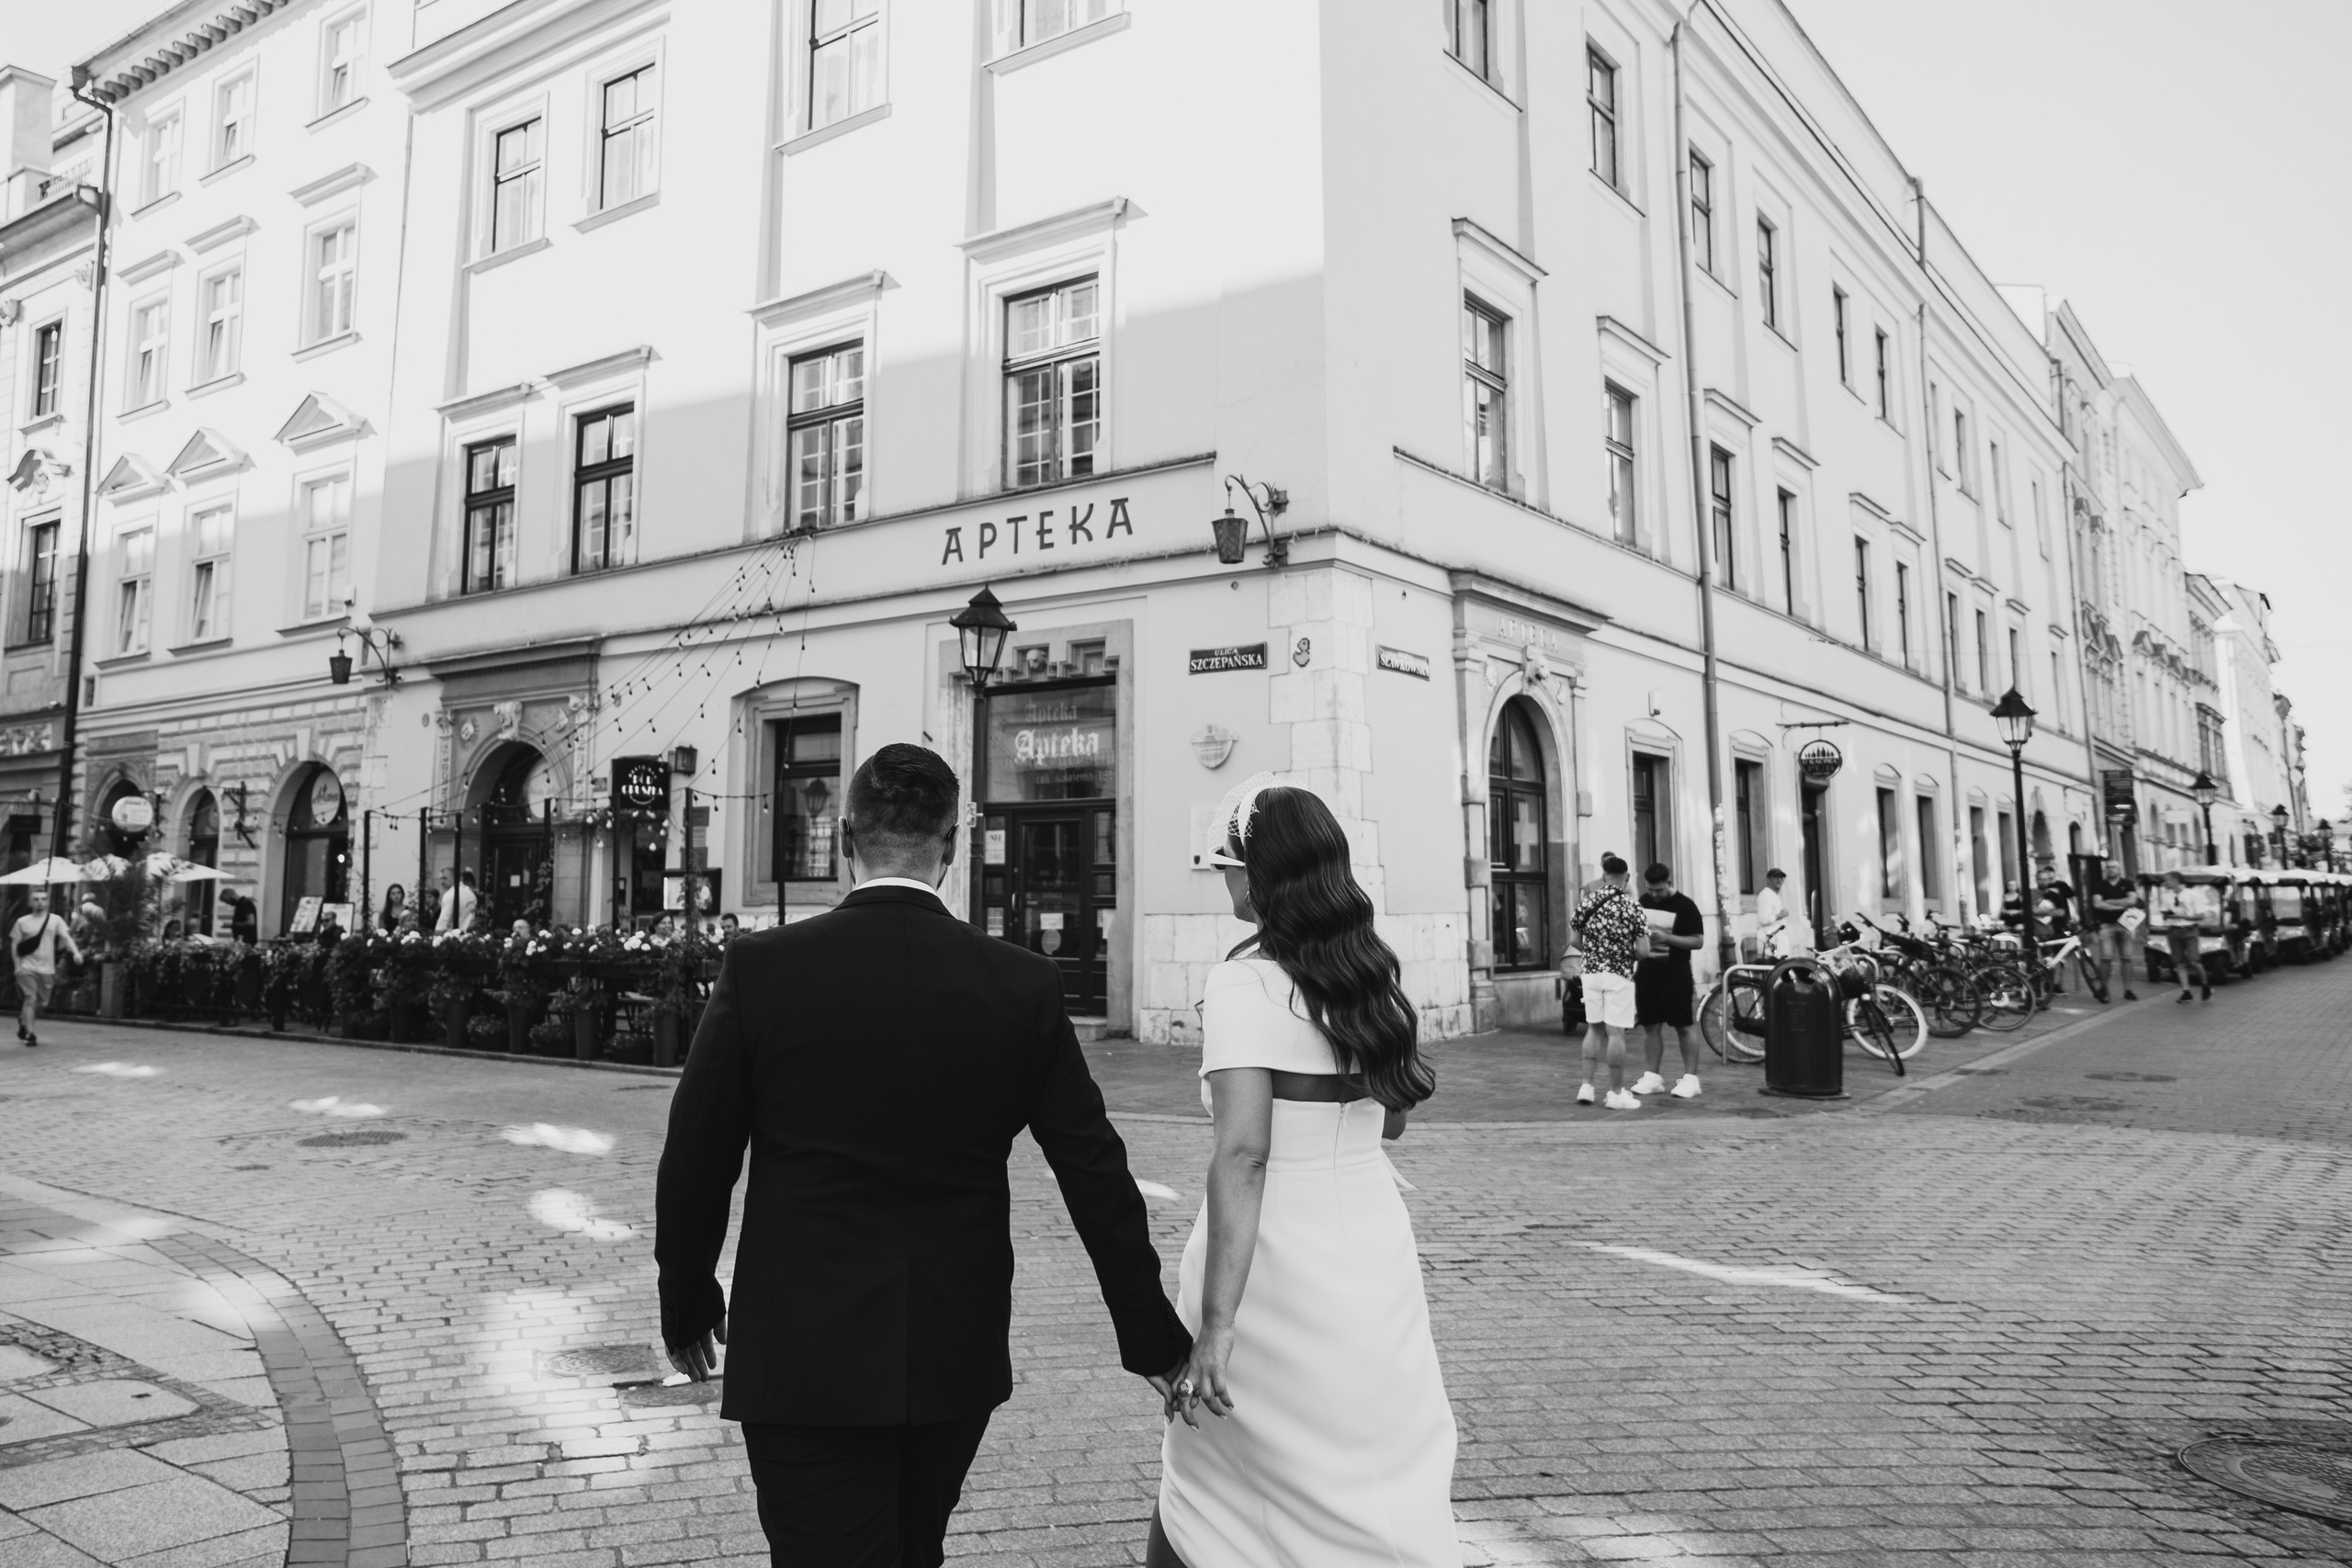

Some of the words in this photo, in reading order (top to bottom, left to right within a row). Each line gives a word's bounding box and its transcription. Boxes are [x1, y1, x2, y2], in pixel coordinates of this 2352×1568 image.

[942, 497, 1134, 566] APTEKA
[1498, 616, 1559, 653] APTEKA
[1190, 653, 1263, 671] SZCZEPAŃSKA
[1215, 648, 1238, 656] ULICA
[1023, 701, 1078, 726] Apteka
[1013, 727, 1100, 765] Apteka
